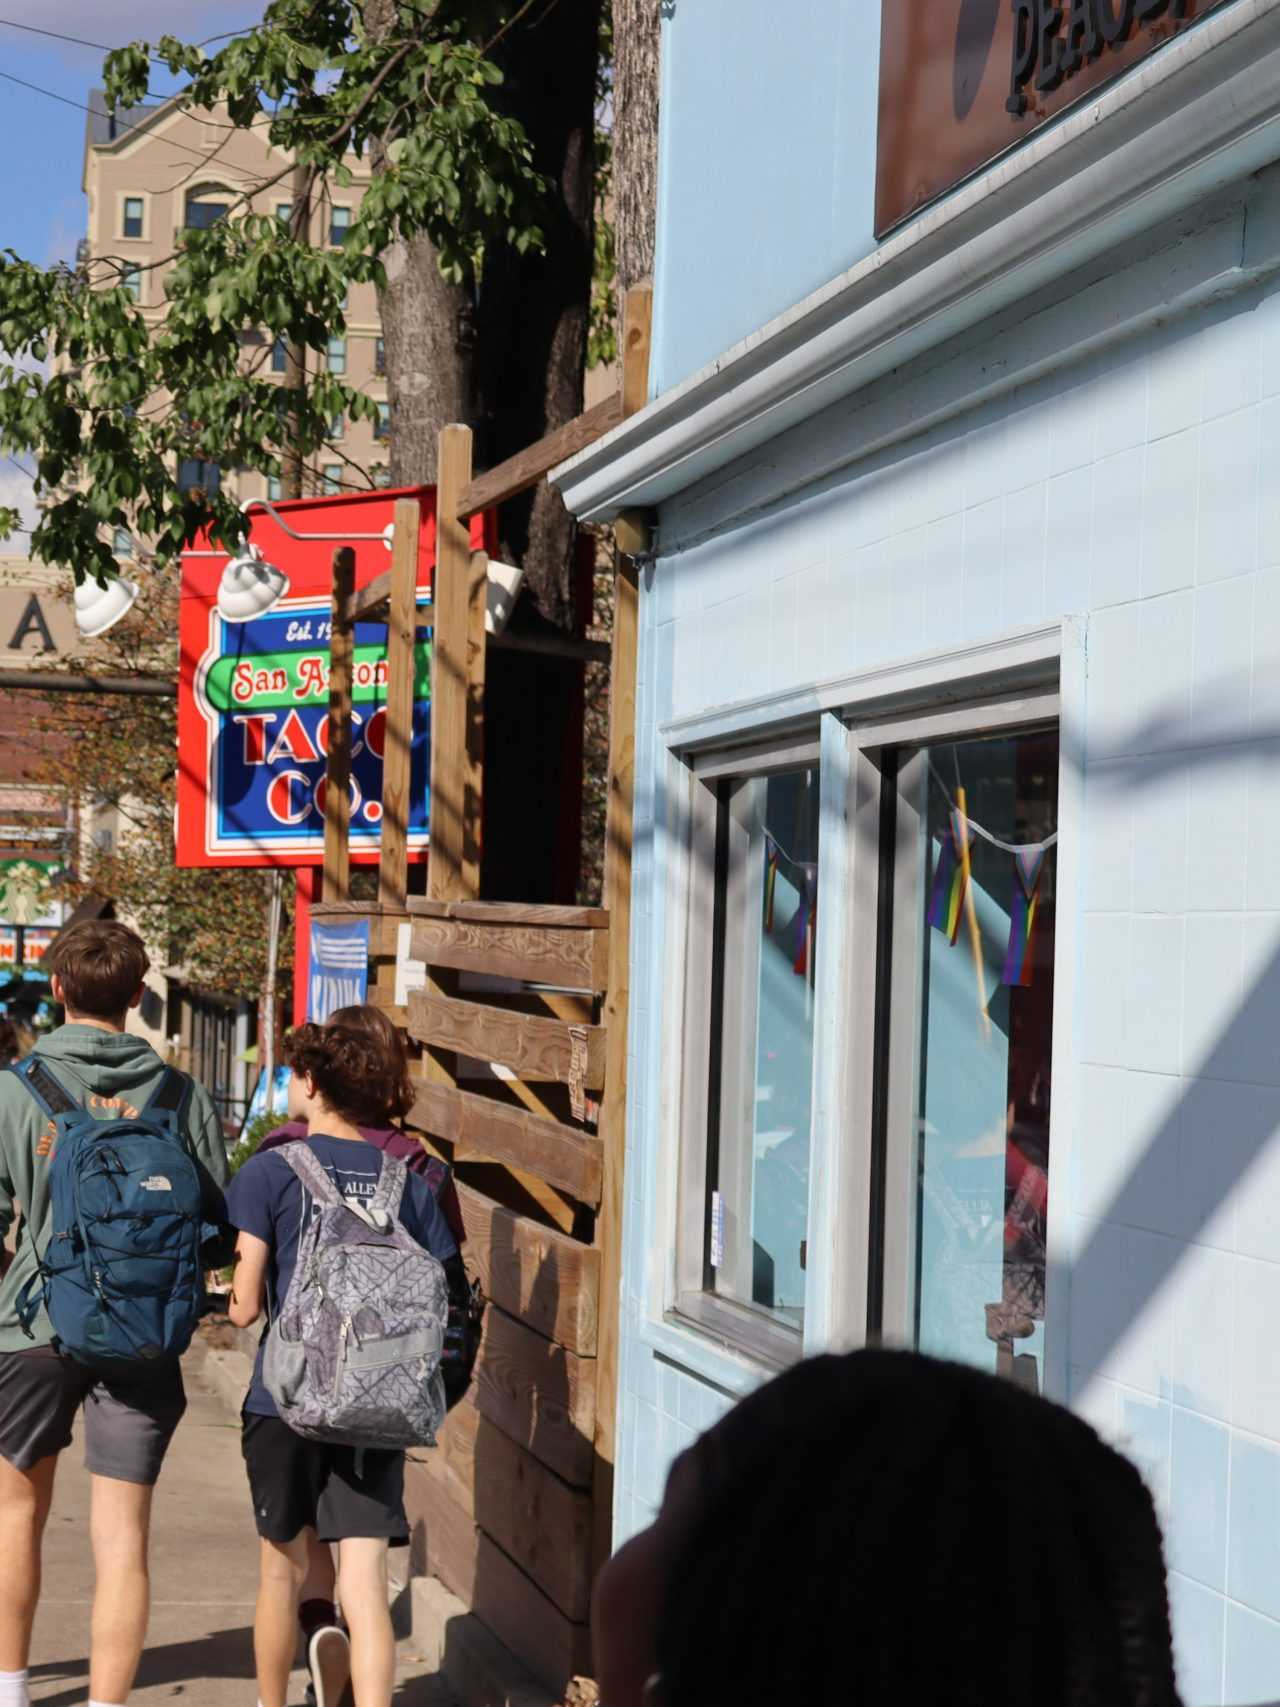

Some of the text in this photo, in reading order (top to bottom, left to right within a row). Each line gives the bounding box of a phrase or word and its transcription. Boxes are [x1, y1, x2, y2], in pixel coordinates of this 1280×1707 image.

[7, 591, 57, 652] A
[285, 620, 313, 642] Est.
[231, 660, 288, 703] San
